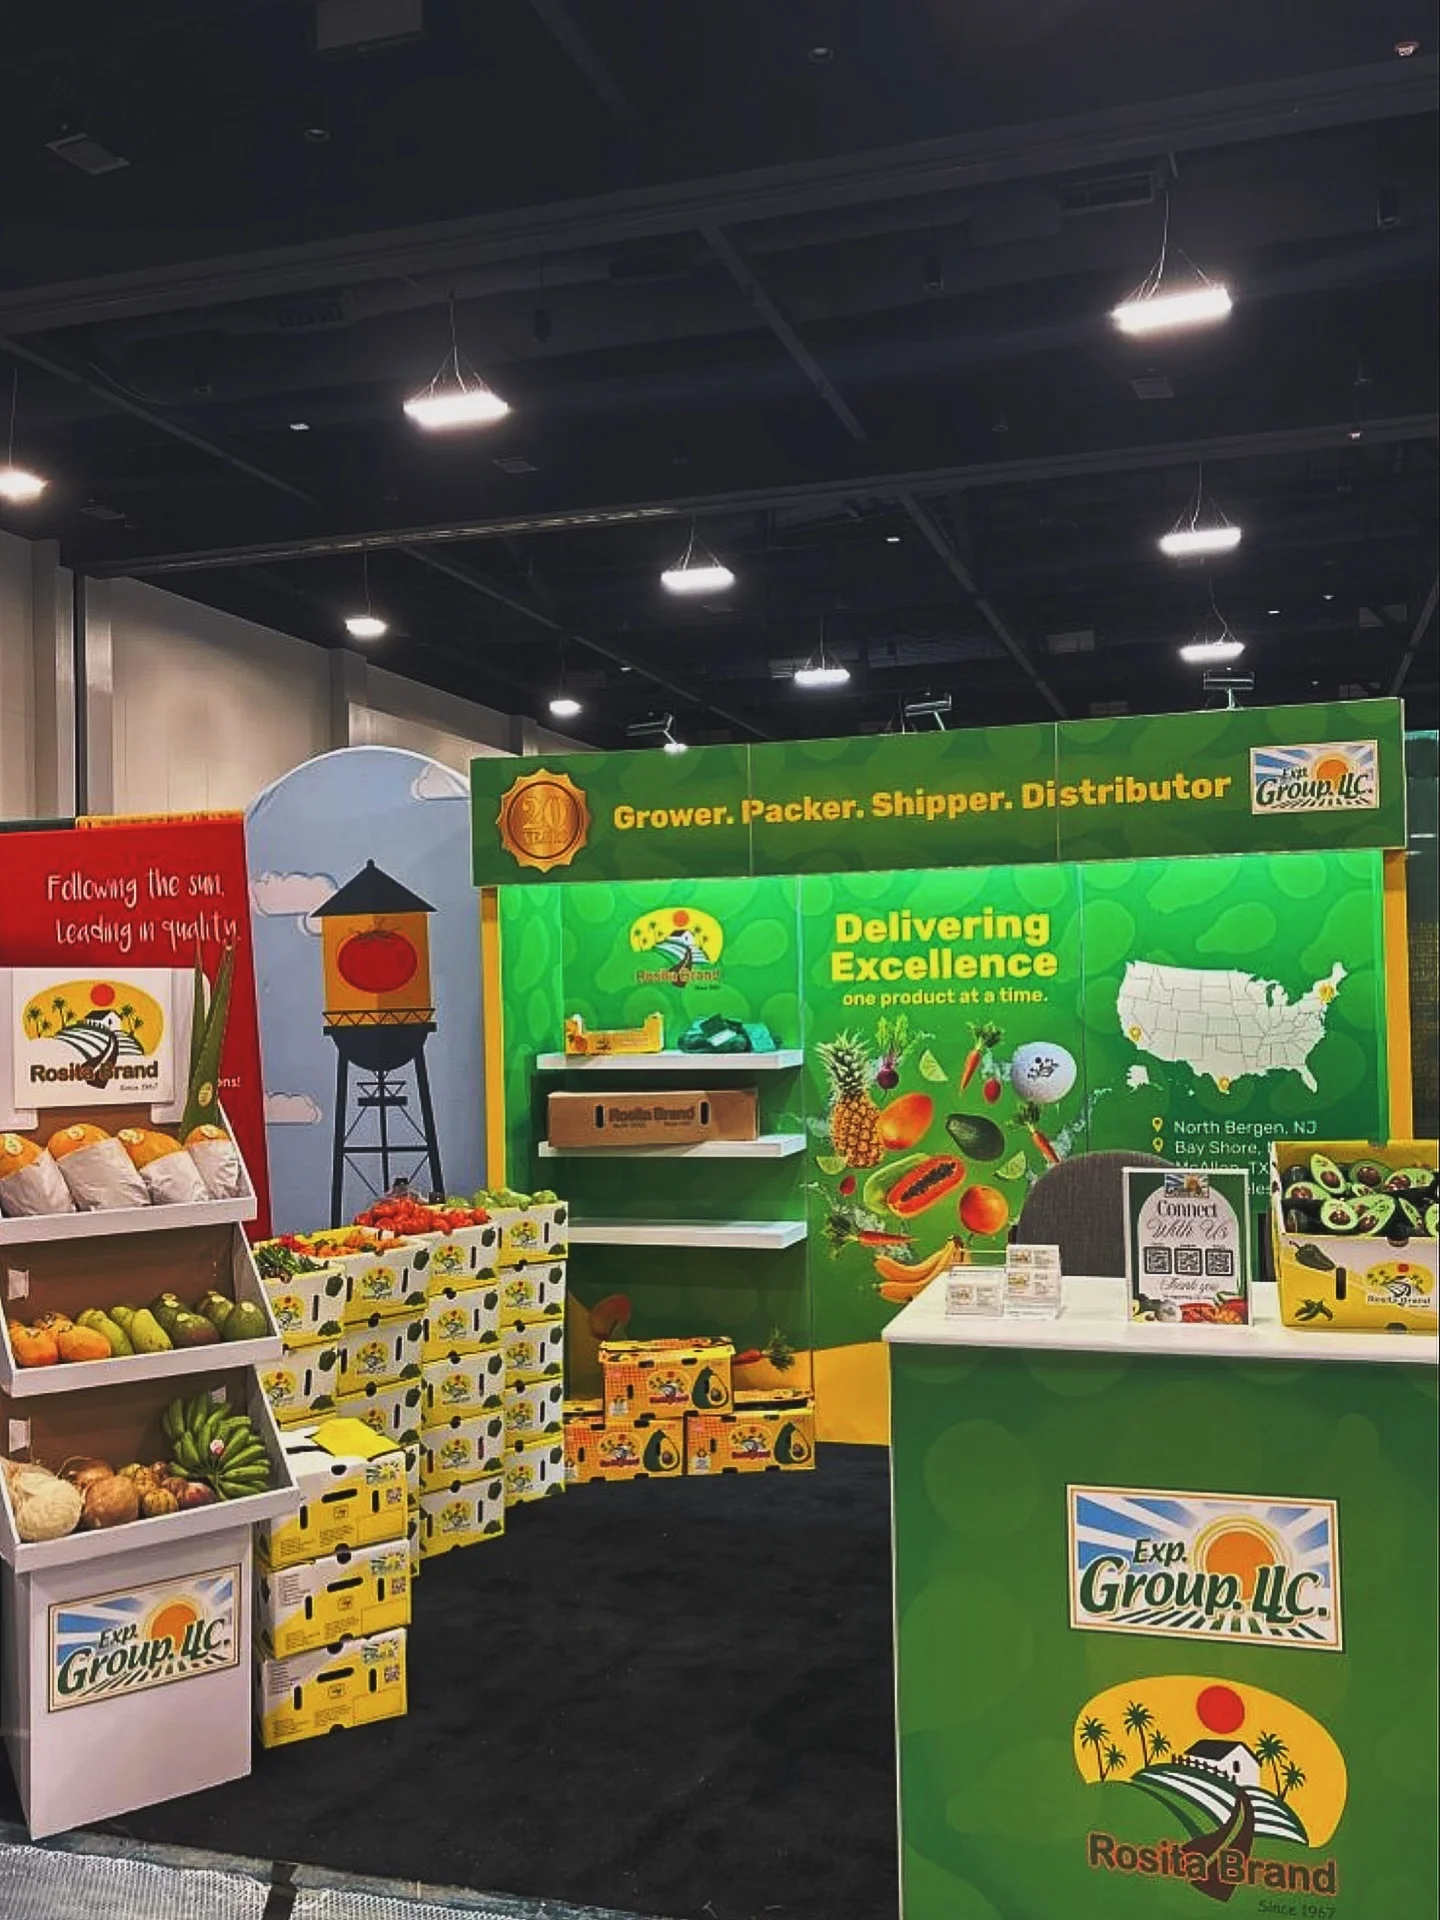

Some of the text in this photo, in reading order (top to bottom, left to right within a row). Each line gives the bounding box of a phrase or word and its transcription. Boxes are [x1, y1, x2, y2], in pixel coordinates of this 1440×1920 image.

[613, 772, 1231, 829] Grower. Packer. Shipper. Distributor
[48, 872, 137, 909] Following
[149, 868, 180, 898] the
[57, 915, 132, 953] Leading
[139, 924, 155, 943] in
[836, 907, 1050, 947] Delivering
[831, 948, 1059, 982] Excellence
[843, 986, 1049, 1008] one product at a time.
[30, 1061, 158, 1083] Rosita Brand
[1174, 1120, 1219, 1134] North
[1294, 1120, 1318, 1134] NJ
[1175, 1141, 1205, 1155] Bay
[1209, 1141, 1261, 1155] Shore,
[1157, 1200, 1218, 1218] Connect
[1132, 1538, 1188, 1567] Exp.
[1080, 1556, 1242, 1616] Group.
[1088, 1832, 1337, 1895] Rosita Brand
[1258, 1899, 1337, 1920] Since 1967
